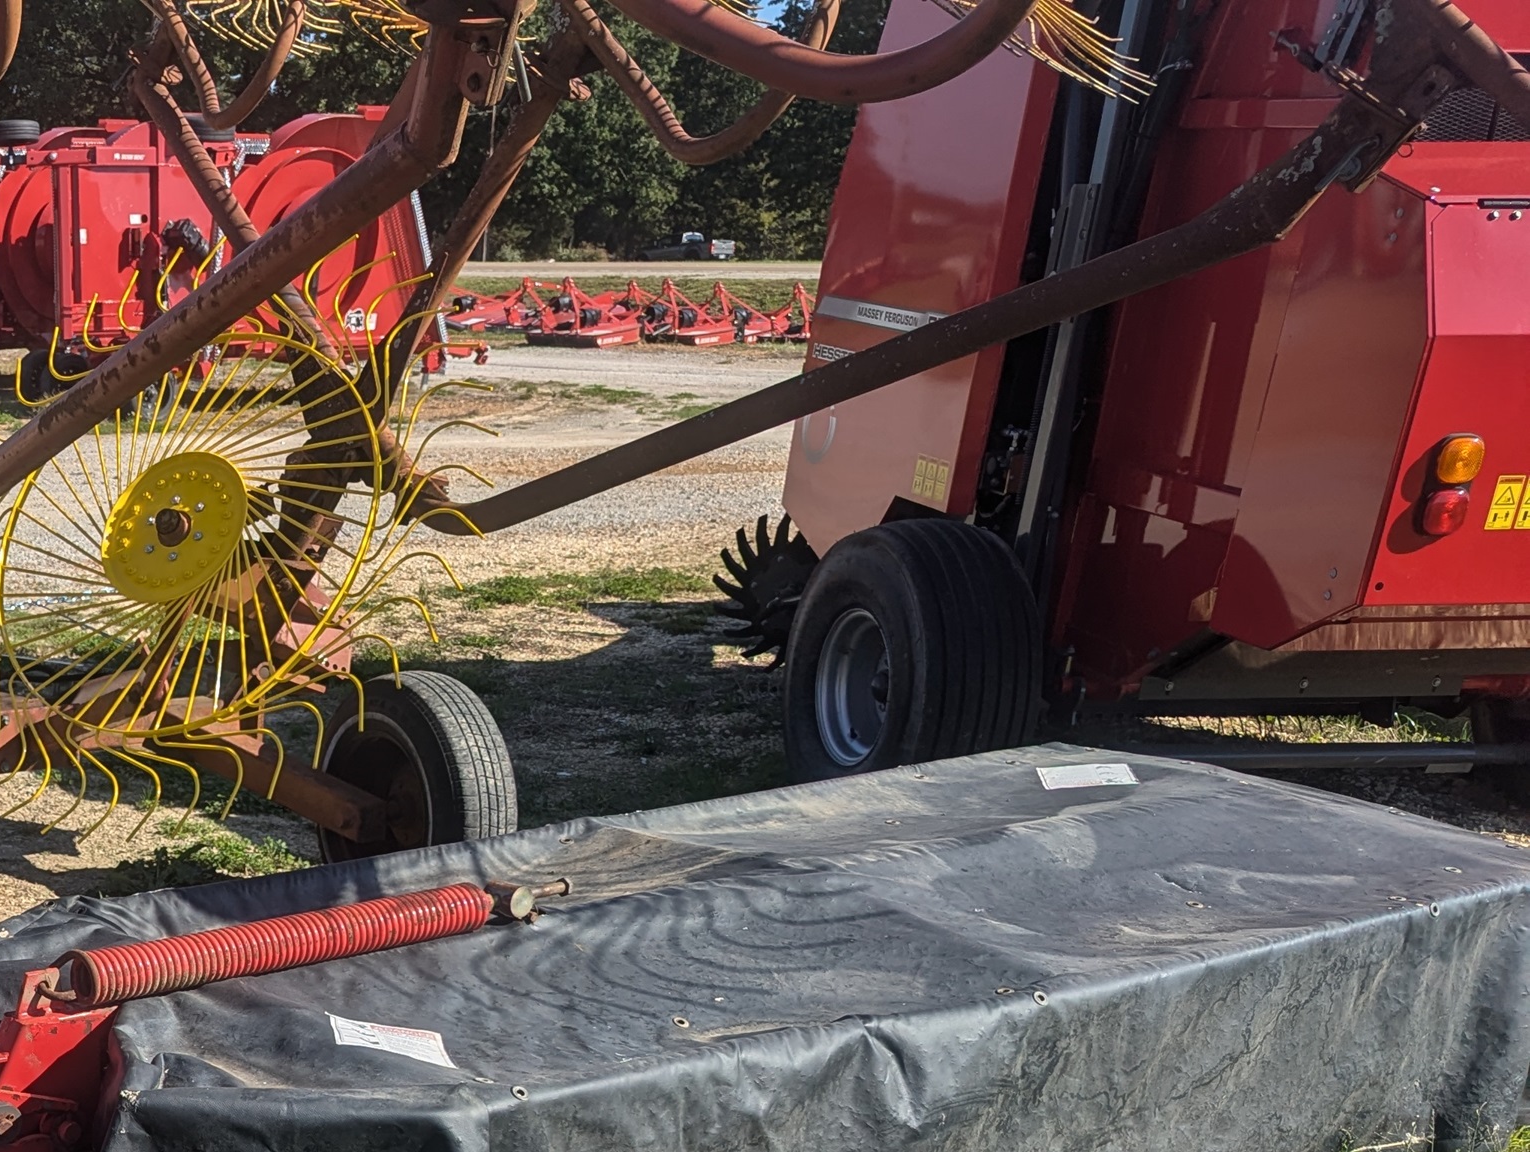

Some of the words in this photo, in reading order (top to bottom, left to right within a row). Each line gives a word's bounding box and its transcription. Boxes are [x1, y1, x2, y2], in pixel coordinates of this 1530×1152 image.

[857, 306, 884, 321] MASSEY
[883, 312, 919, 327] FERGUSON
[813, 343, 855, 361] HESST
